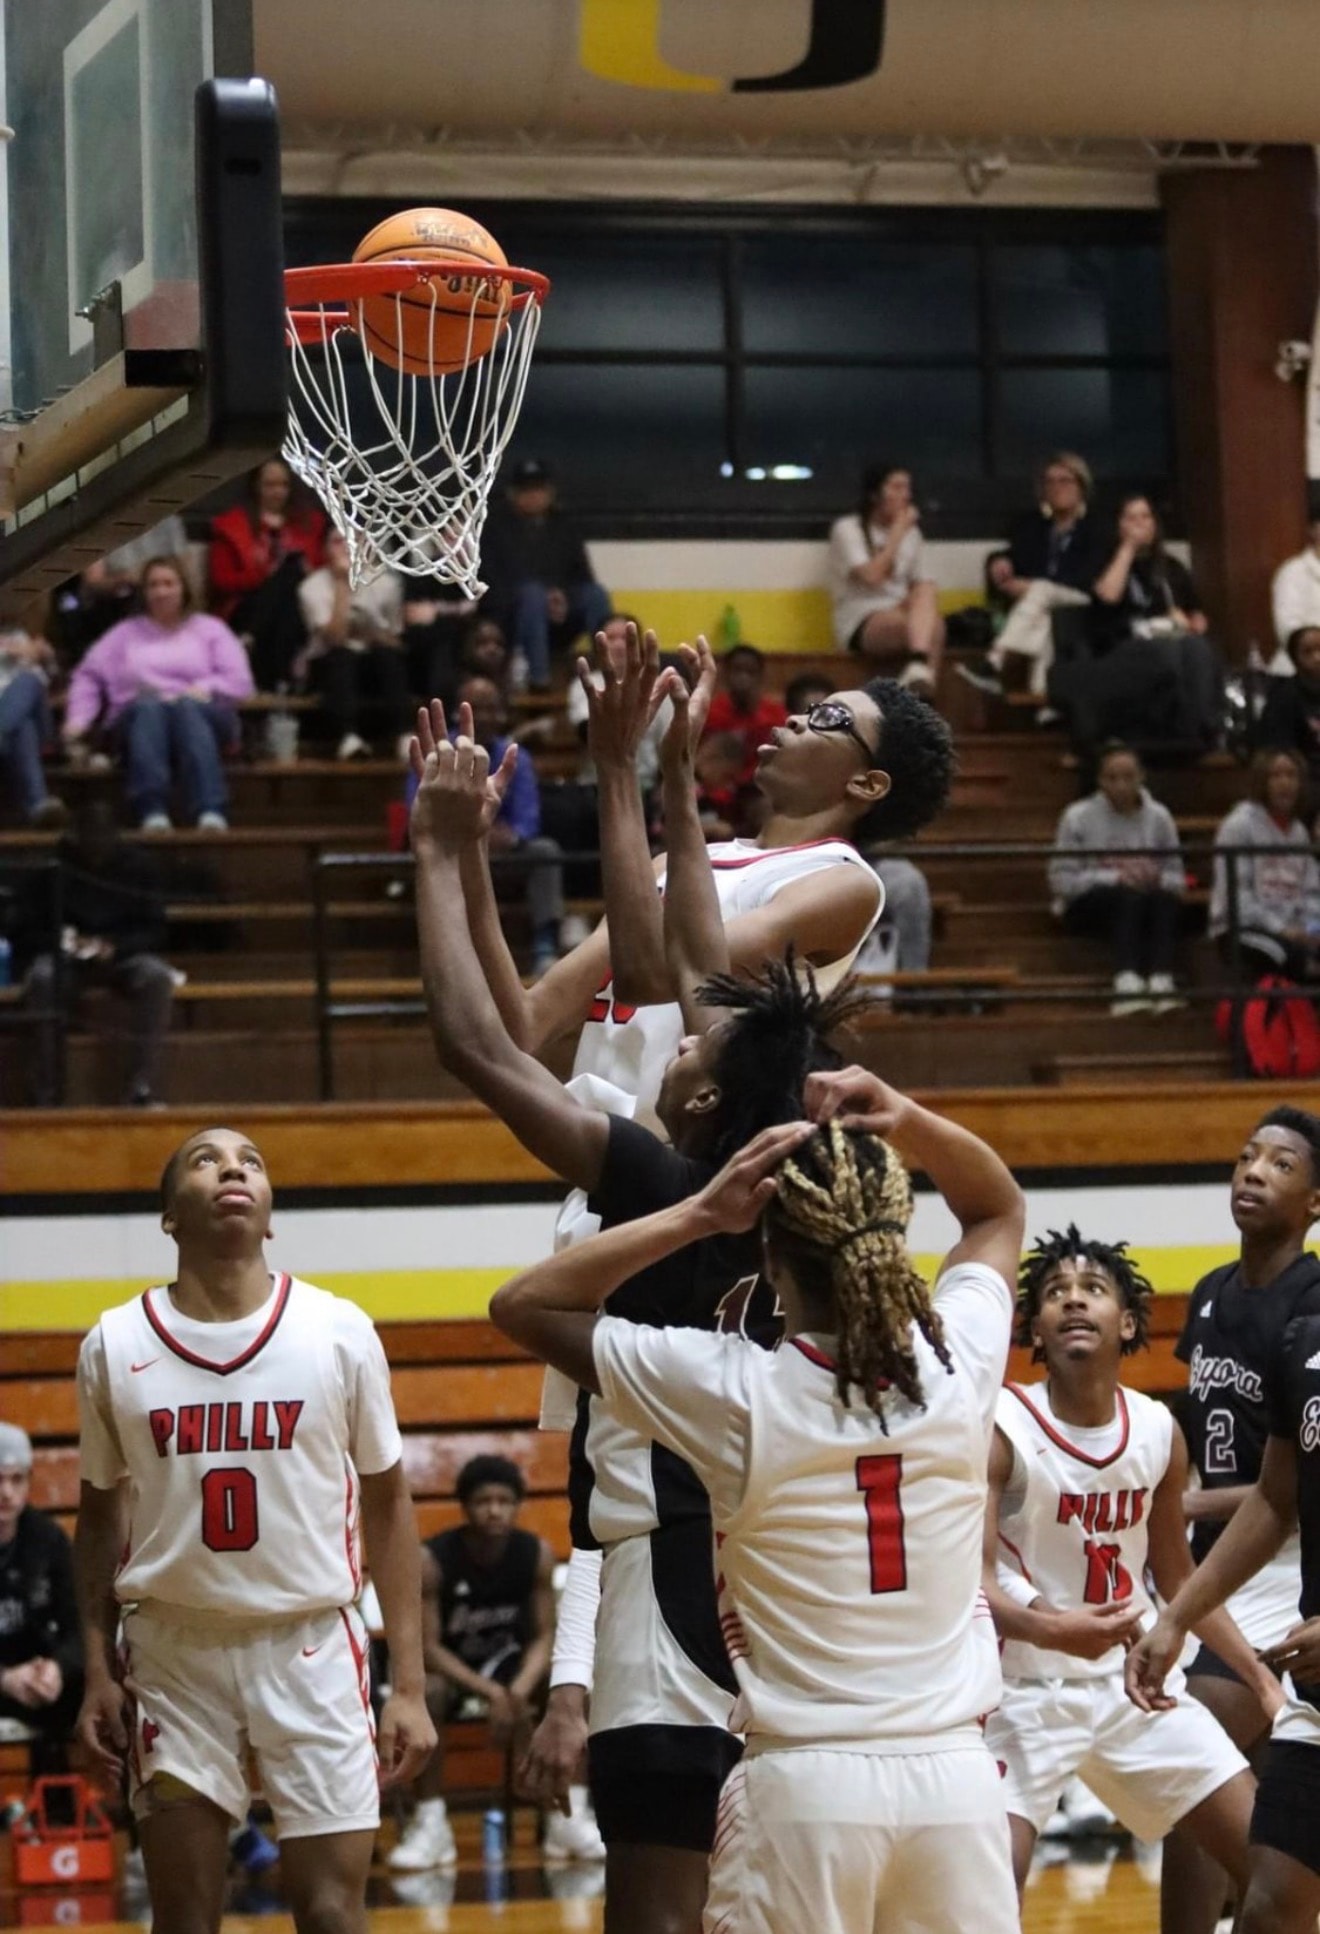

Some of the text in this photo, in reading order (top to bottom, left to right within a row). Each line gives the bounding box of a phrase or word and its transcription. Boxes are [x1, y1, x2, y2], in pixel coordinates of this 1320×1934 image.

[149, 1400, 304, 1458] PHILLY
[1205, 1408, 1237, 1473] 2
[201, 1467, 259, 1552] 0
[855, 1453, 907, 1595] 1
[51, 1845, 80, 1879] G
